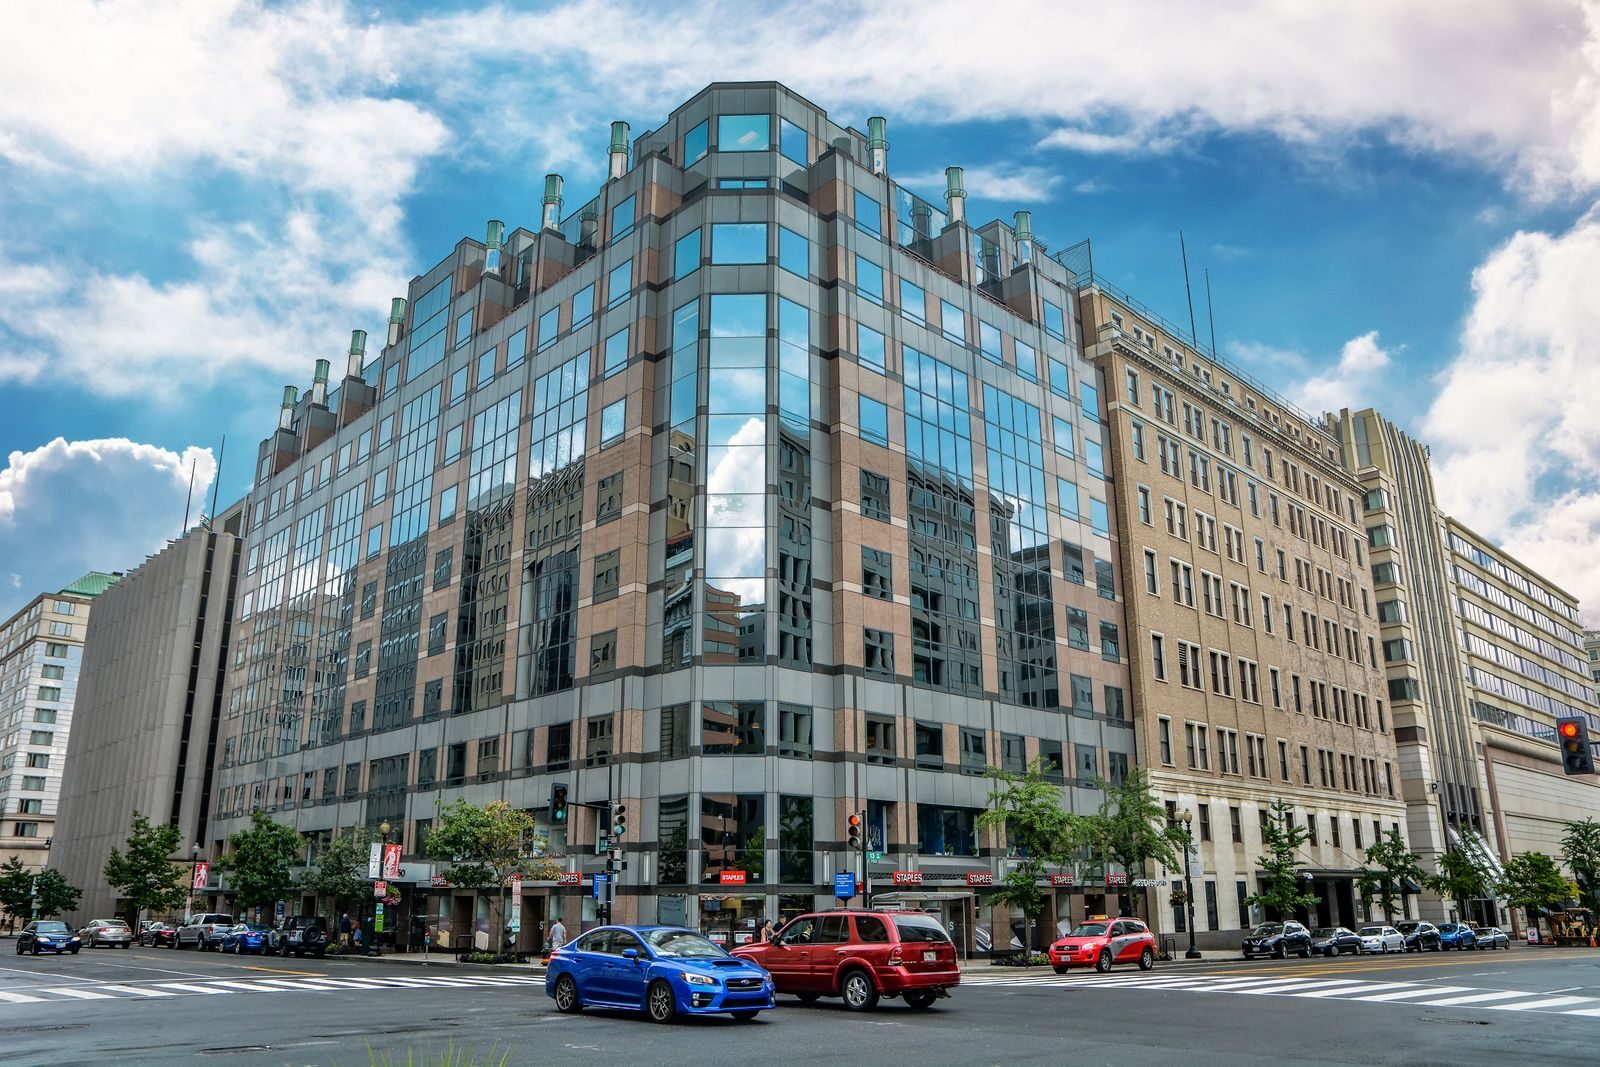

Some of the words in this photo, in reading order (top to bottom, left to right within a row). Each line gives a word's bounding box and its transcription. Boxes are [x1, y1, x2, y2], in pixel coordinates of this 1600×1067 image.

[896, 873, 923, 883] STAPLES
[969, 874, 993, 883] STAPLES
[1054, 876, 1073, 884] STAPLES
[1108, 876, 1127, 884] STAPLES
